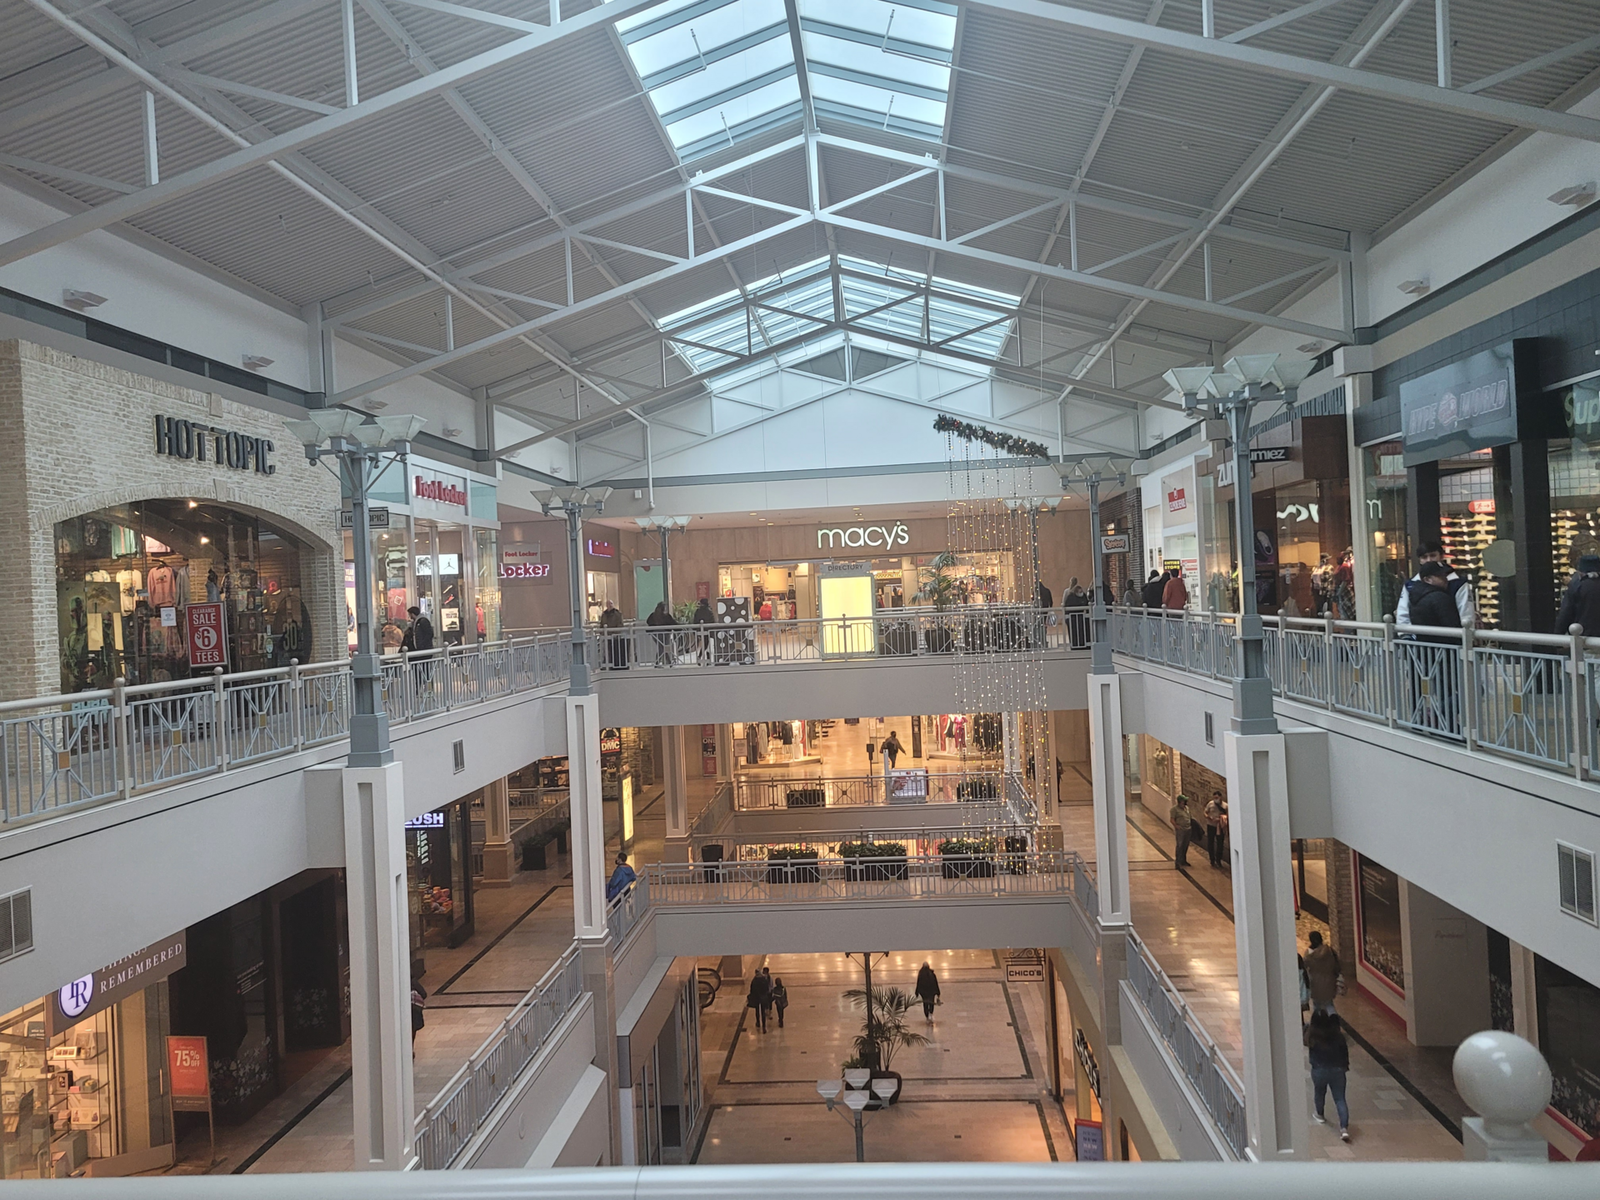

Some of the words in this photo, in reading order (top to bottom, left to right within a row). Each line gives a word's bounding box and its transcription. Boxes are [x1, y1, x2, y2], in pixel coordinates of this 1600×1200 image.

[1408, 402, 1438, 436] HYPE
[1460, 379, 1508, 420] WORLD
[154, 414, 209, 462] HOT
[209, 426, 276, 475] TOPIC
[817, 520, 909, 550] macy's
[827, 564, 864, 572] DIRECTORY
[193, 613, 217, 625] SALE
[196, 628, 212, 648] $6
[195, 651, 220, 663] TEES
[100, 943, 183, 994] REMEMBERED
[1008, 969, 1042, 977] CHICO'S
